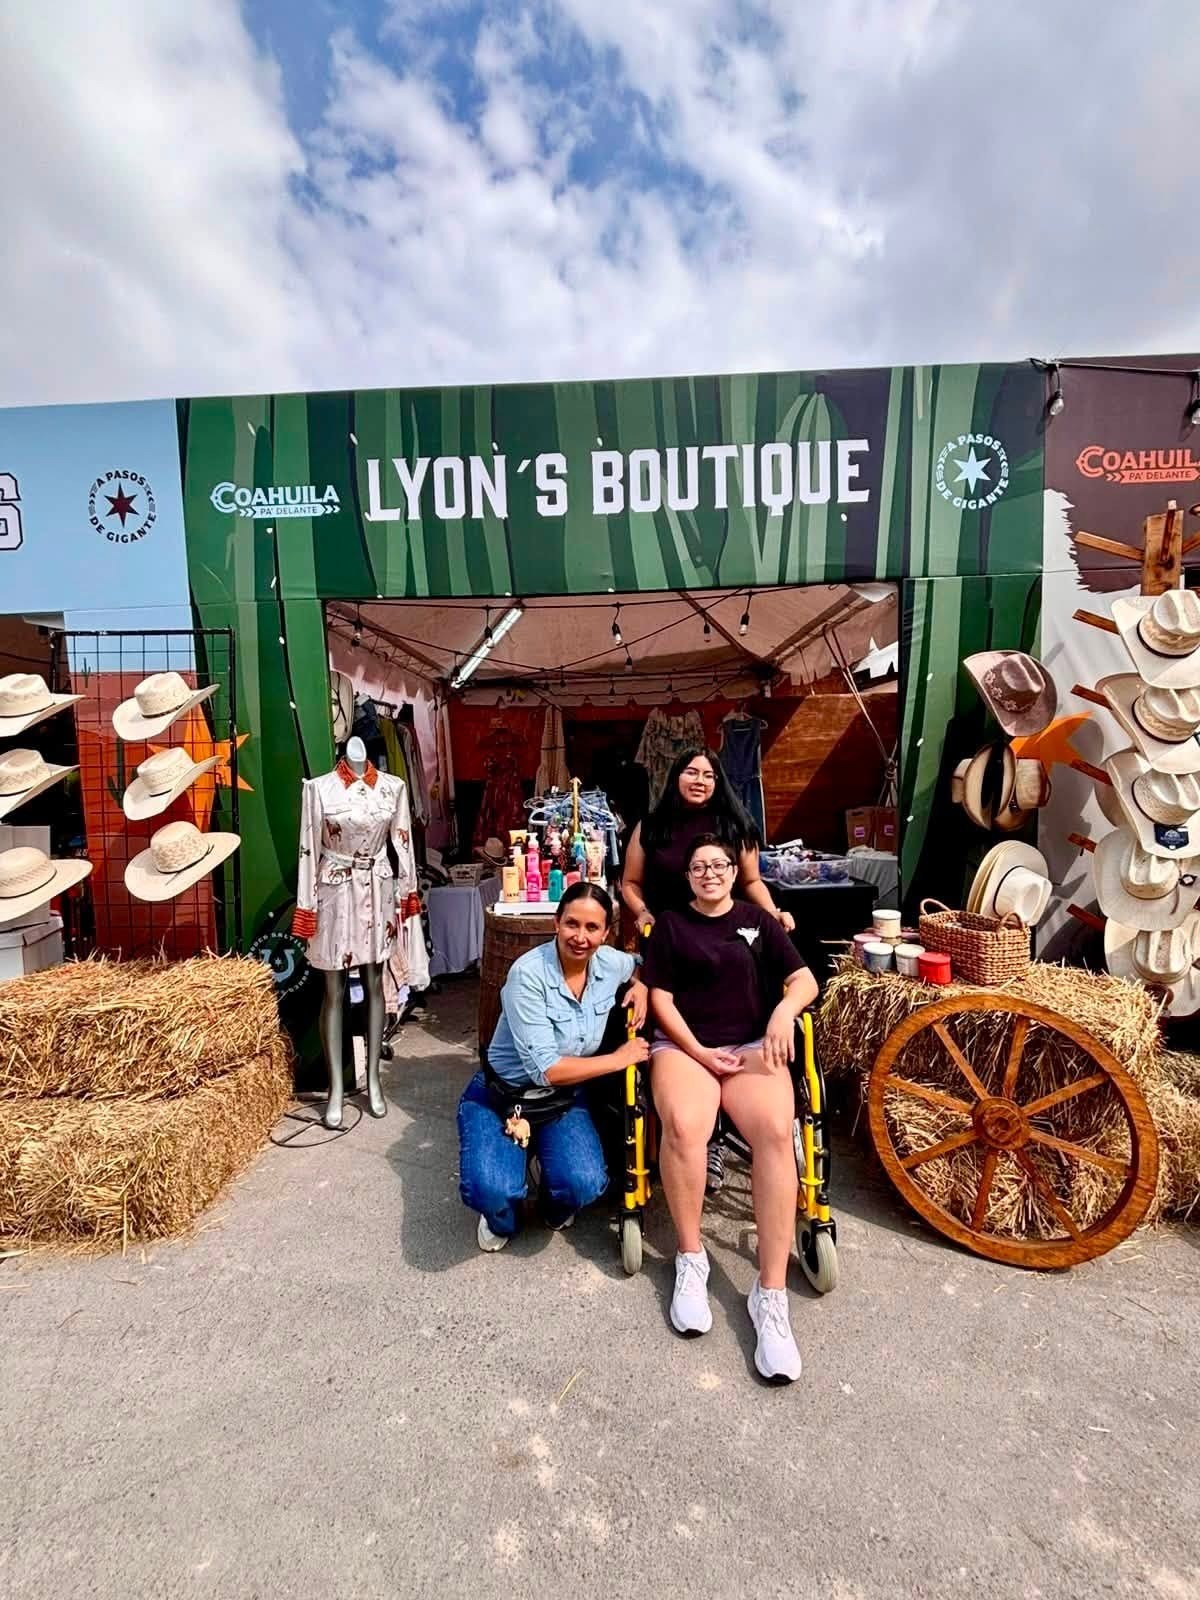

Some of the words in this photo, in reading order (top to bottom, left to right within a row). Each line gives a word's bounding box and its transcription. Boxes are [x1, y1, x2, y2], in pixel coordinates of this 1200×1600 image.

[947, 442, 957, 452] A
[957, 434, 1001, 451] PASOS
[1075, 446, 1200, 478] COAHUIL
[1146, 470, 1192, 480] DELANTE
[96, 478, 105, 488] A
[105, 470, 146, 486] PASOS
[591, 439, 870, 516] BOUTIQUE
[209, 481, 340, 513] COAHUILA
[936, 480, 953, 500] DE
[952, 478, 1009, 510] GIGANTE
[276, 505, 318, 515] DELANTE
[89, 516, 105, 534] DE
[106, 514, 157, 544] GIGANTE
